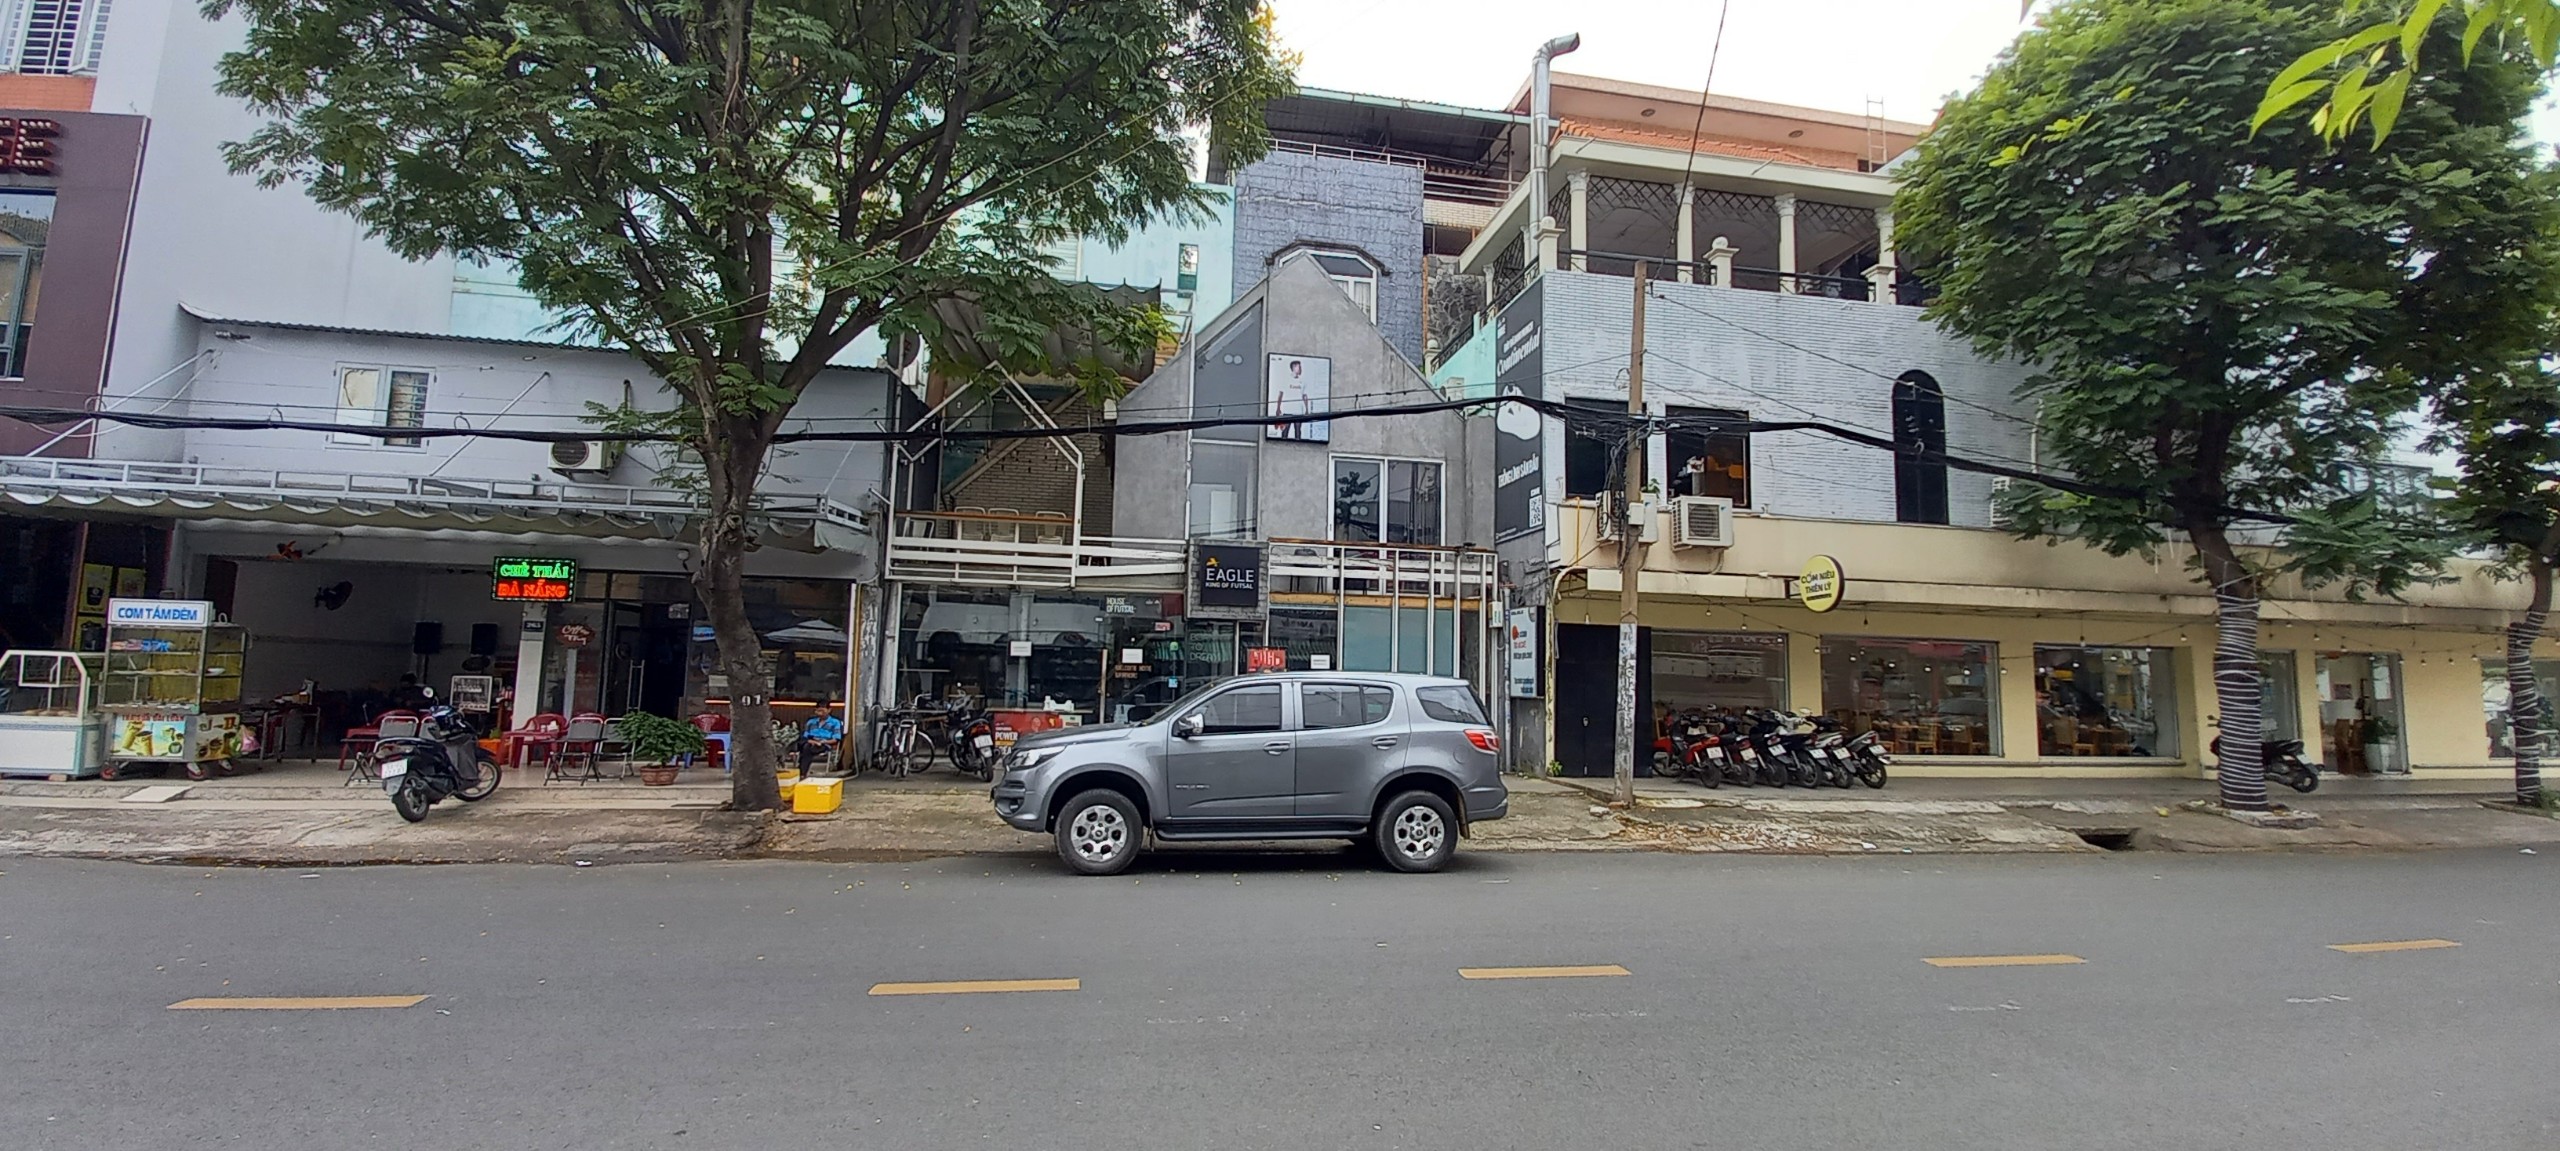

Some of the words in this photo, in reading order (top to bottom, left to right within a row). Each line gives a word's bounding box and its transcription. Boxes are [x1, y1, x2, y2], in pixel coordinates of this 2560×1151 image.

[500, 562, 530, 577] CHÈ
[532, 563, 569, 579] THÁI
[1206, 568, 1255, 583] EAGLE
[498, 581, 520, 597] ĐÀ
[1106, 597, 1126, 605] HOUSE
[1106, 605, 1114, 613] OF
[1115, 605, 1135, 614] FUTSAL
[995, 732, 1018, 741] POWER
